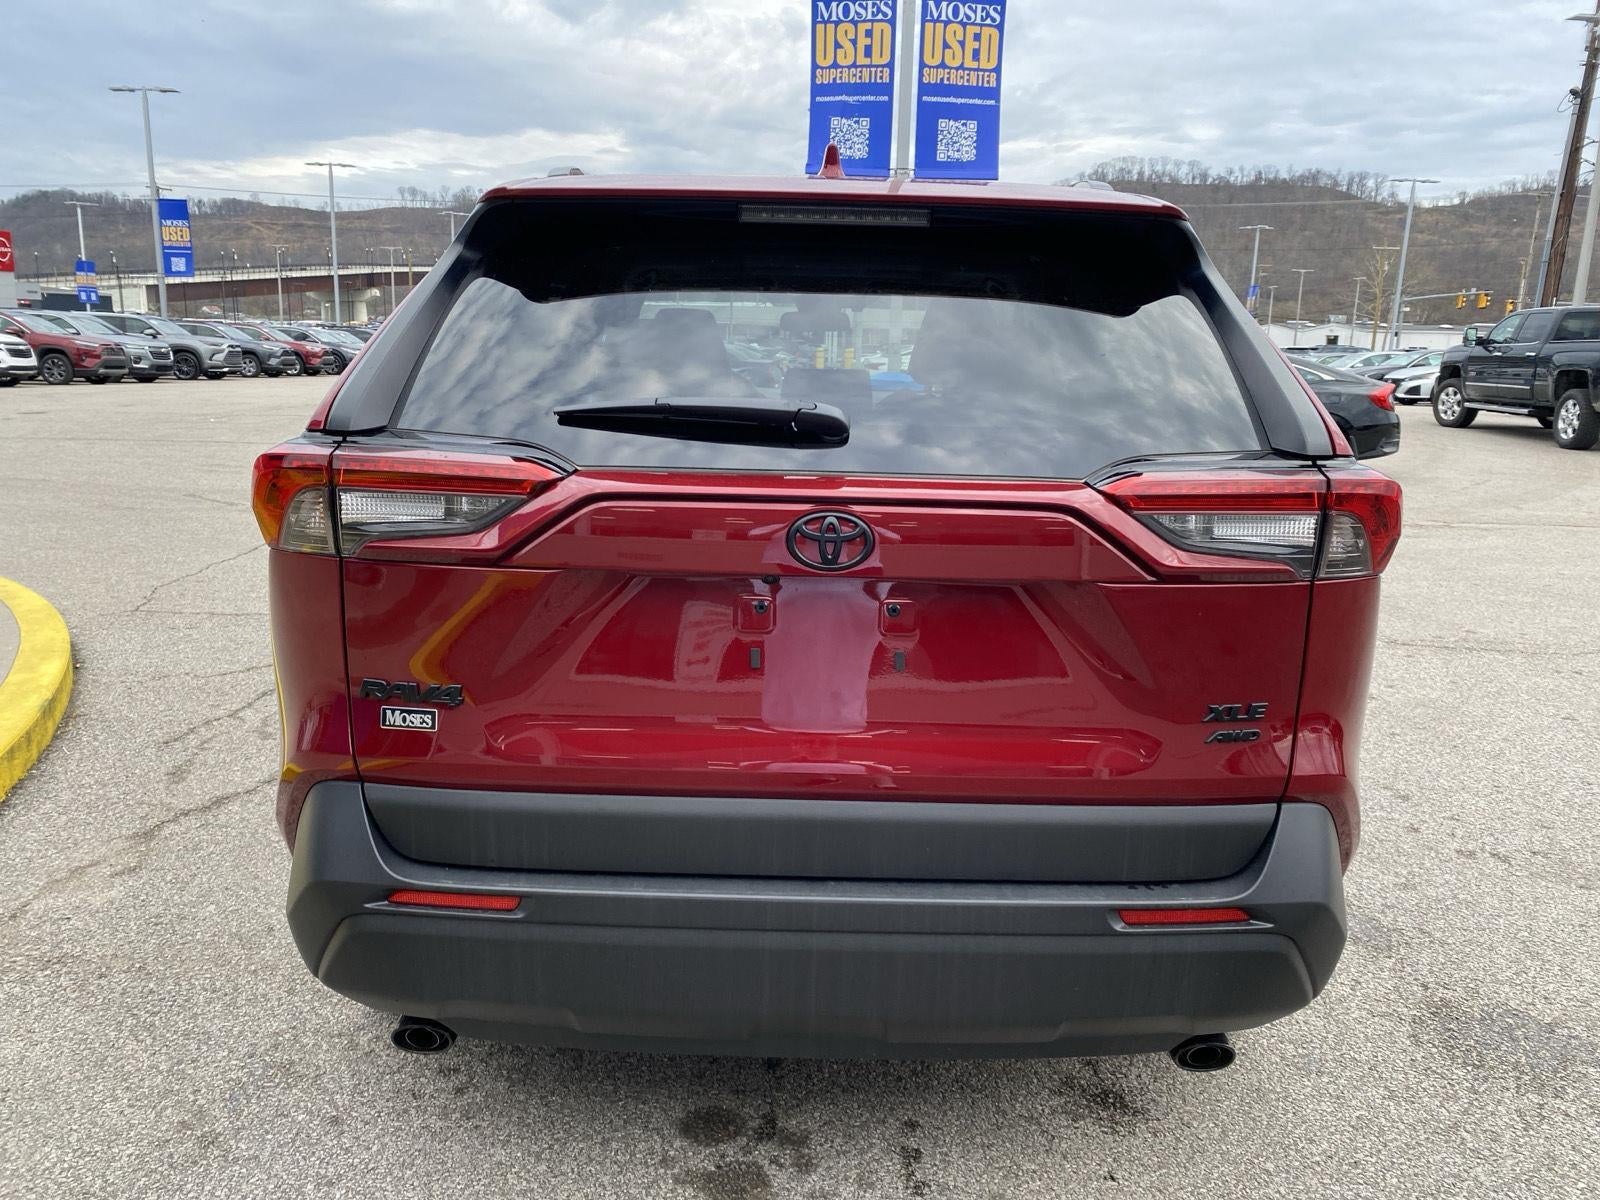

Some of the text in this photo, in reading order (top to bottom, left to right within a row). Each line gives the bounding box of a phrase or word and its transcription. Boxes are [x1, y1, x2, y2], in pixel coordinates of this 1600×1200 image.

[816, 0, 892, 21] MOSES
[925, 0, 1001, 25] MOSES
[815, 22, 892, 67] USED
[923, 21, 1000, 69] USED
[815, 67, 890, 84] SUPERCENTER
[922, 67, 997, 87] SUPERCENTER
[815, 95, 889, 103] mosesusedsupercenter.com
[922, 95, 997, 106] mosesusedsupercenter.com
[161, 219, 189, 227] MOSES
[162, 226, 190, 242] USED
[360, 678, 465, 709] RAV4
[1202, 702, 1269, 722] XLE
[1204, 729, 1262, 744] AWD
